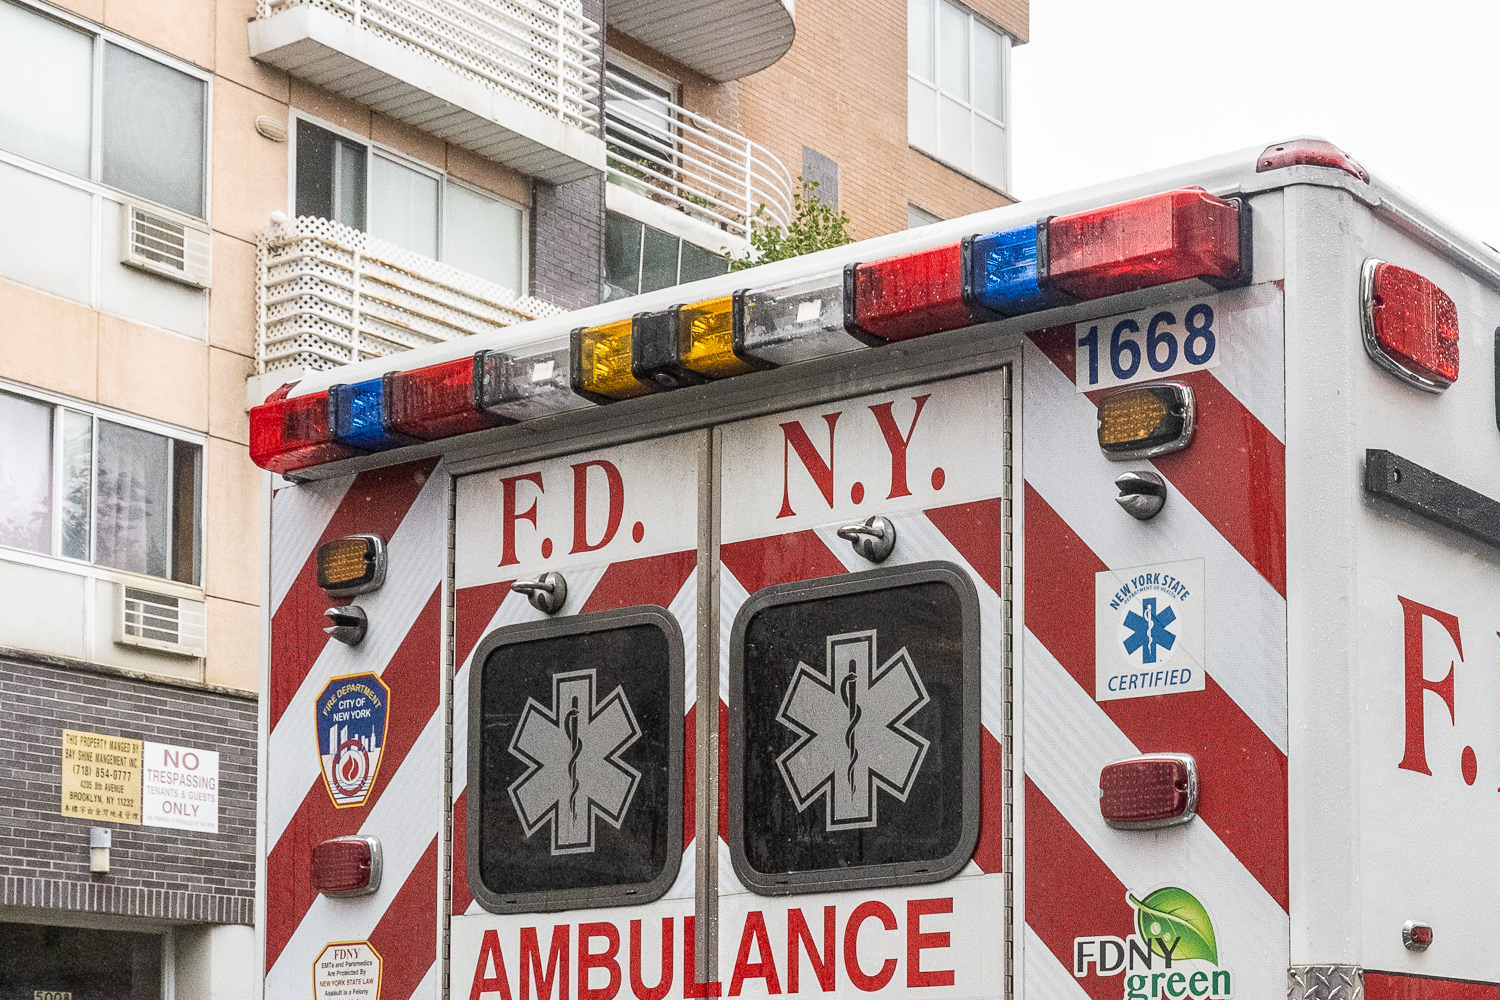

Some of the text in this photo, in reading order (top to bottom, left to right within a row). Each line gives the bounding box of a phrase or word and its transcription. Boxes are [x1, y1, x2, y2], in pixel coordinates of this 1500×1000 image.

[1078, 303, 1216, 385] 1668
[498, 393, 945, 567] F.D. N.Y.
[1110, 573, 1190, 610] NEW YORK STATE
[1124, 586, 1152, 604] DEPARTMENT
[1161, 587, 1177, 599] HEALTH
[1108, 669, 1192, 691] CERTIFIED
[323, 684, 382, 717] FIRE DEPARTMENT
[339, 698, 366, 710] CITY OF
[333, 709, 371, 722] NEW YORK
[66, 734, 78, 745] THIS
[80, 736, 107, 749] PROPERTY
[133, 744, 139, 754] BY
[66, 749, 76, 759] BAY
[78, 750, 93, 762] SHINE
[164, 749, 200, 771] NO
[73, 764, 132, 781] (718) 854-0777
[147, 769, 216, 790] TRESPASSING
[105, 784, 124, 794] AVENUE
[147, 786, 216, 803] TENANTS & GUESTS
[70, 792, 134, 808] BROOKLYN, NY 11232
[163, 801, 199, 817] ONLY
[334, 948, 361, 960] FDNY
[1078, 936, 1181, 972] FDNY
